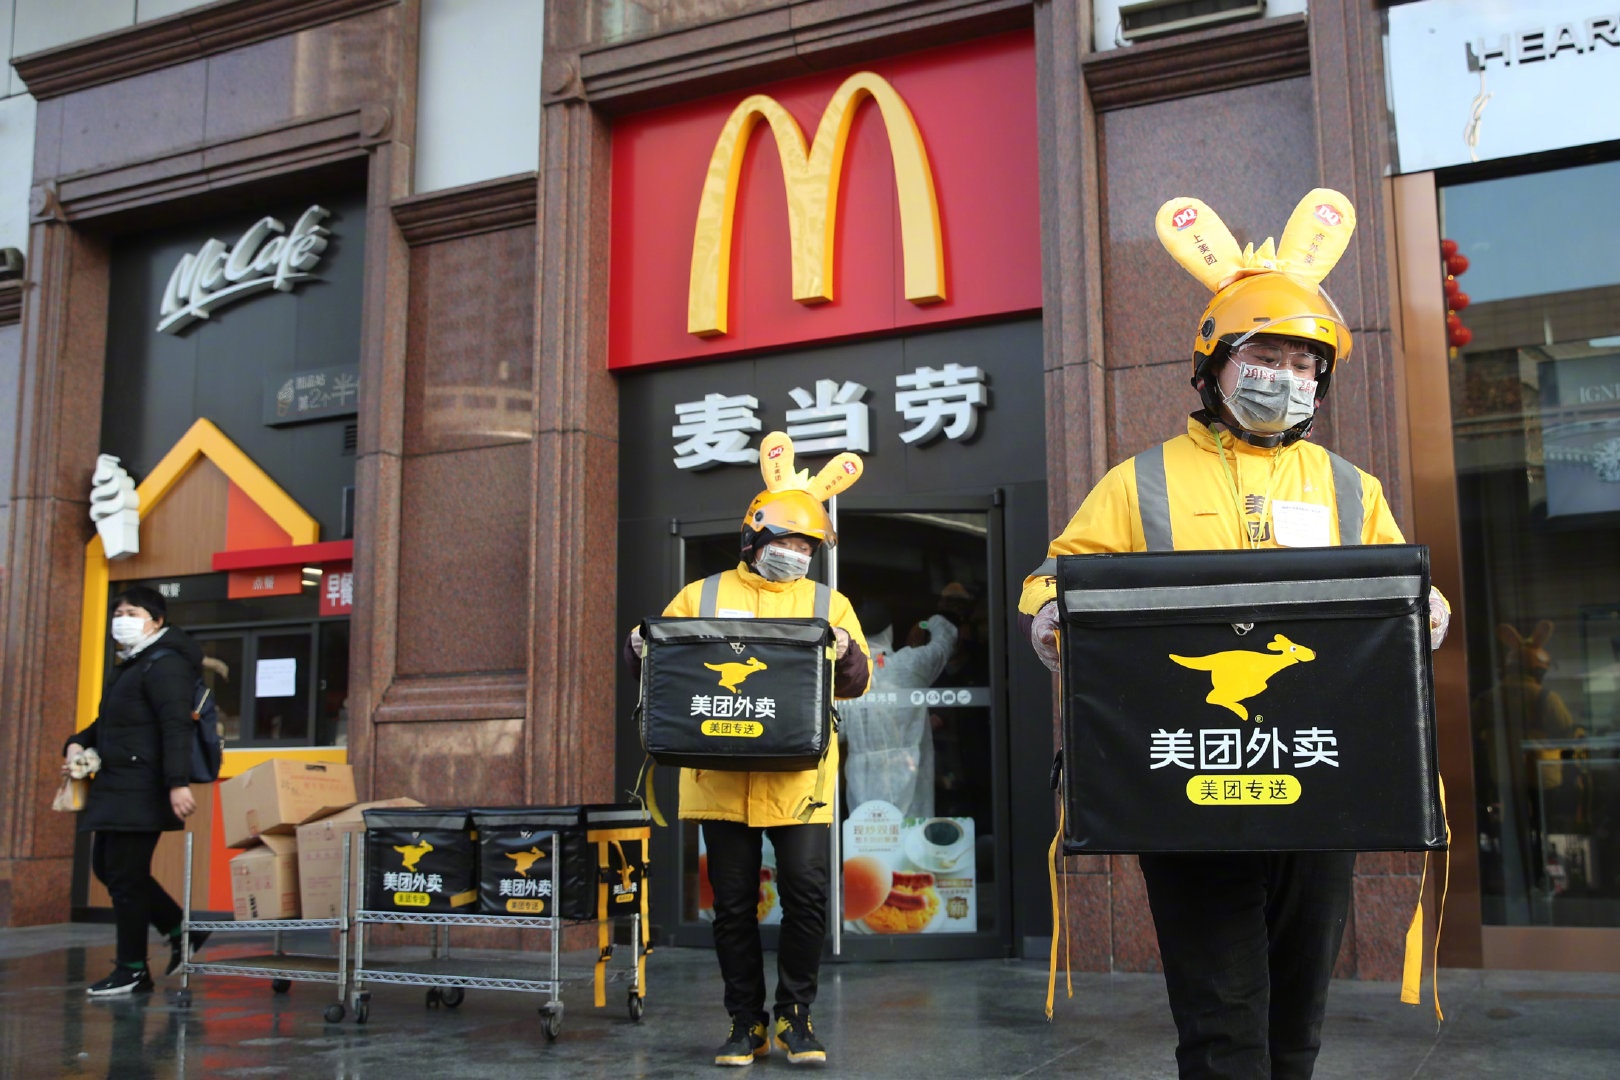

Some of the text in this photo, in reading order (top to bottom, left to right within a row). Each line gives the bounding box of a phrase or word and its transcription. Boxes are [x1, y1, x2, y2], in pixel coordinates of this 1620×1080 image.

[1173, 207, 1198, 228] DQ
[1316, 204, 1341, 226] DQ
[1193, 233, 1217, 266] 上美团
[1304, 233, 1325, 264] 点外卖
[156, 205, 330, 332] McCafé
[297, 373, 361, 411] 第2个半
[672, 363, 987, 470] 麦当劳
[1245, 494, 1270, 542] 美团
[690, 694, 776, 719] 美团外卖
[709, 722, 755, 735] 美团专送
[1150, 727, 1340, 770] 美团外卖
[1200, 779, 1288, 800] 美团专送
[383, 871, 443, 893] 美团外卖
[499, 879, 552, 897] 美团外卖
